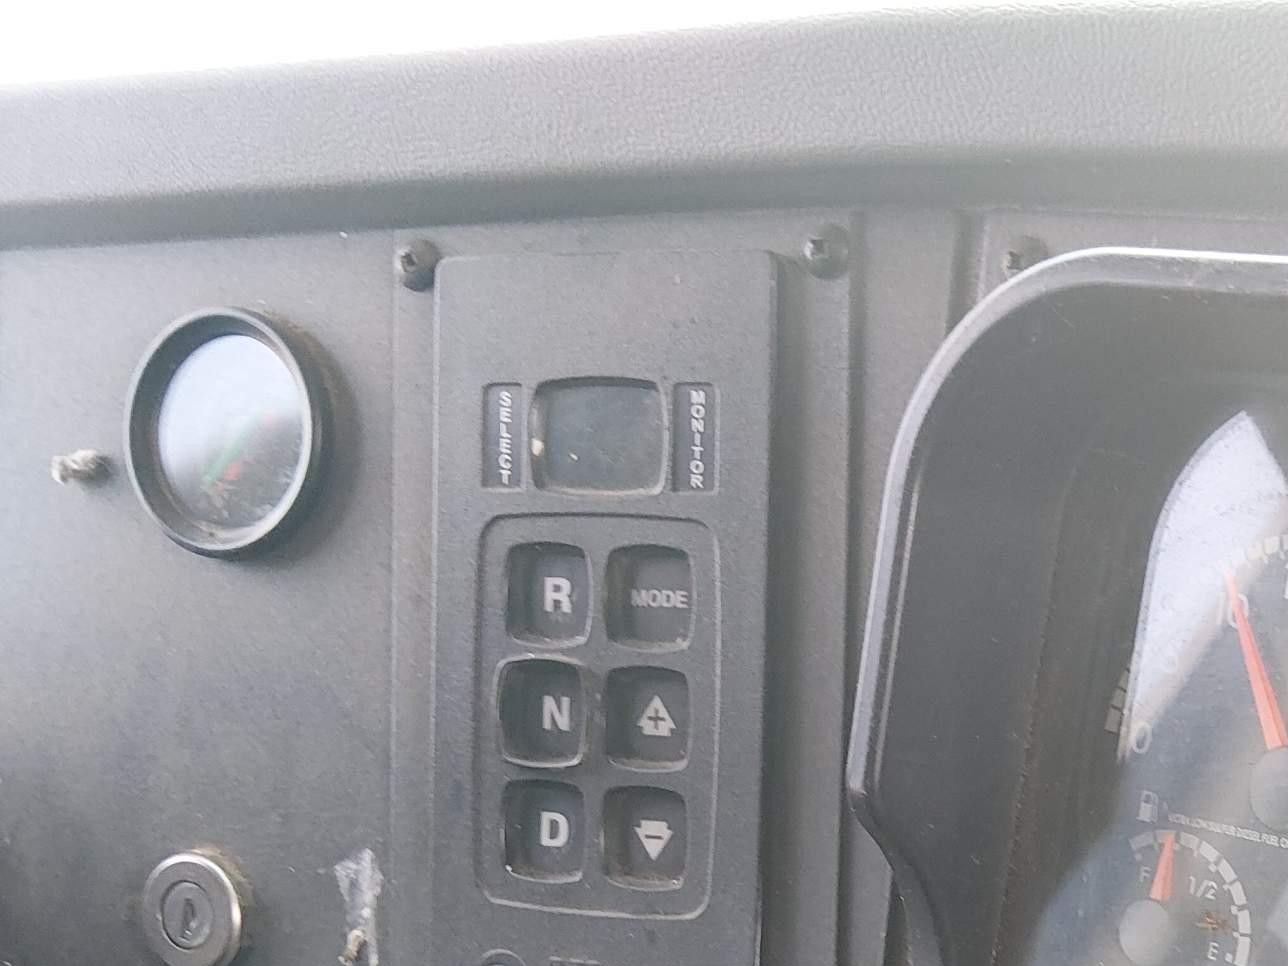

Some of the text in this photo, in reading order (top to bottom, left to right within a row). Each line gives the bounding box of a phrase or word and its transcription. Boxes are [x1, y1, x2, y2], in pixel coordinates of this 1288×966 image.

[497, 390, 513, 485] SELECT
[689, 390, 706, 489] MONITOR
[543, 577, 573, 614] R
[631, 589, 689, 609] MODE
[542, 695, 570, 732] N
[1132, 721, 1151, 754] 0
[540, 811, 569, 847] D
[1188, 876, 1218, 900] 1/2
[1207, 942, 1219, 961] E
